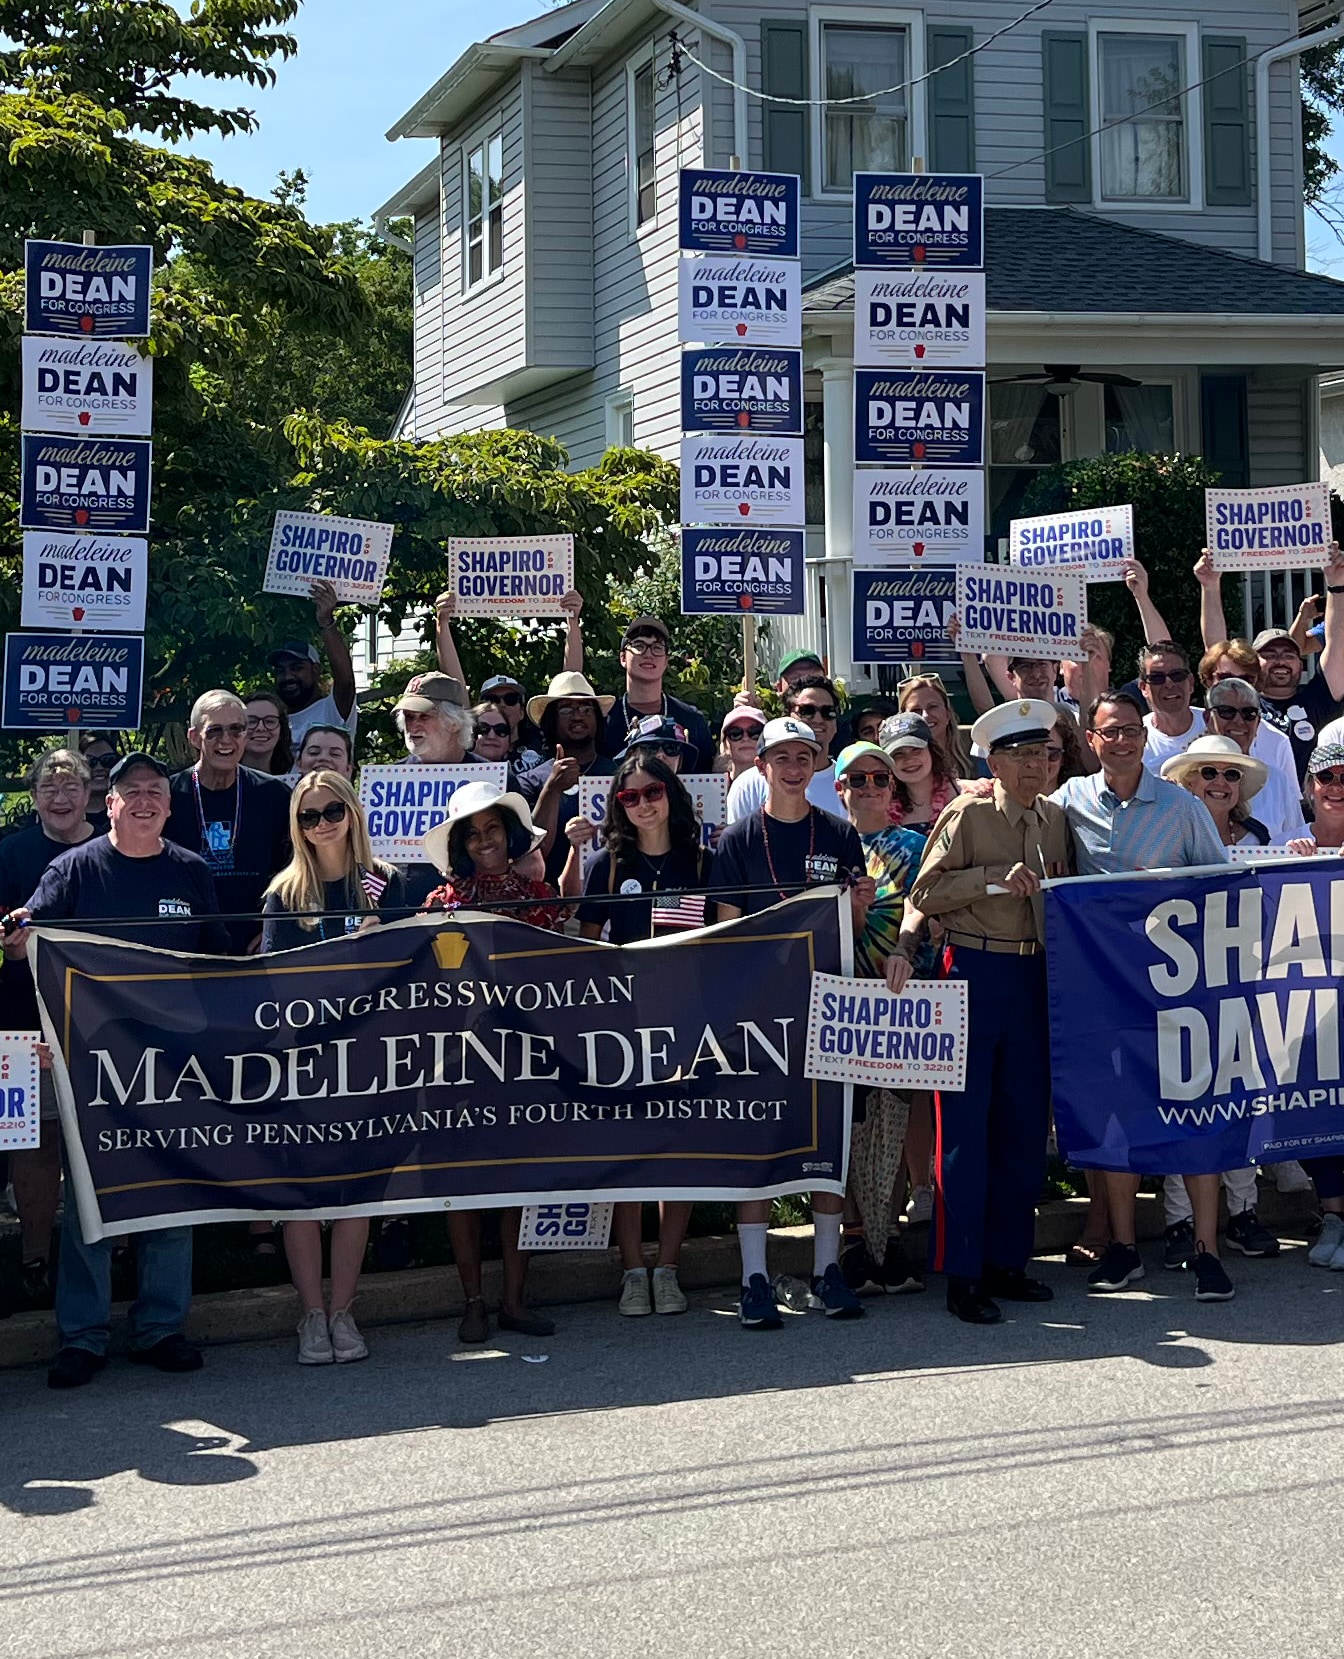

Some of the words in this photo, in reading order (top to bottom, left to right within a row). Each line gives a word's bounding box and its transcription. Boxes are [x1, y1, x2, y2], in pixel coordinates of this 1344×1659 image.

[693, 175, 786, 197] madeleine
[870, 178, 967, 201] madeleine
[692, 196, 786, 224] DEAN
[868, 204, 968, 231] DEAN
[692, 221, 716, 231] FOR
[720, 223, 785, 236] CONGRESS
[868, 232, 894, 243] FOR
[898, 233, 967, 244] CONGRESS
[42, 248, 136, 272] madeleine
[694, 263, 787, 284] madeleine
[41, 273, 135, 303] DEAN
[692, 285, 787, 310] DEAN
[871, 276, 969, 298] madeleine
[42, 300, 65, 311] FOR
[68, 302, 134, 316] CONGRESS
[870, 302, 969, 329] DEAN
[39, 344, 137, 368] madeleine
[695, 352, 788, 372] madeleine
[38, 368, 137, 399] DEAN
[694, 375, 789, 400] DEAN
[870, 375, 969, 397] madeleine
[869, 401, 969, 428] DEAN
[869, 429, 894, 439] FOR
[898, 430, 968, 441] CONGRESS
[37, 441, 136, 465] madeleine
[696, 441, 790, 461] madeleine
[36, 467, 135, 497] DEAN
[694, 464, 791, 489] DEAN
[869, 473, 967, 496] madeleine
[37, 493, 59, 504] FOR
[63, 495, 133, 510] CONGRESS
[869, 500, 969, 526] DEAN
[1216, 499, 1302, 525] SHAPIRO
[280, 524, 362, 556] SHAPIRO
[696, 532, 790, 553] madeleine
[1020, 520, 1102, 545] SHAPIRO
[1217, 522, 1323, 550] GOVERNOR
[39, 537, 133, 562] madeleine
[458, 550, 544, 572] SHAPIRO
[1020, 538, 1124, 567] GOVERNOR
[39, 563, 132, 592] DEAN
[276, 550, 377, 582] GOVERNOR
[696, 556, 791, 581] DEAN
[459, 575, 564, 596] GOVERNOR
[697, 582, 721, 592] FOR
[725, 583, 791, 593] CONGRESS
[866, 574, 956, 596] madelein
[965, 577, 1054, 608] SHAPIRO
[965, 605, 1076, 637] GOVERNOR
[867, 629, 893, 639] FOR
[897, 628, 950, 640] CONGRE
[22, 639, 128, 662] madeleine
[20, 665, 128, 692] DEAN
[20, 693, 48, 704] FOR
[52, 694, 126, 705] CONGRESS
[254, 974, 636, 1030] CONGRESSWOMAN
[822, 993, 931, 1028] SHAPIRO
[819, 1026, 954, 1062] GOVERNOR
[88, 1028, 560, 1106] MADELEINE
[578, 1018, 794, 1088] DEAN
[819, 1057, 845, 1065] TEXT
[848, 1059, 903, 1069] FREEDOM
[924, 1064, 953, 1072] 32210
[98, 1124, 233, 1152] SERVING
[508, 1102, 633, 1125] FOURTH
[645, 1100, 788, 1121] DISTRICT
